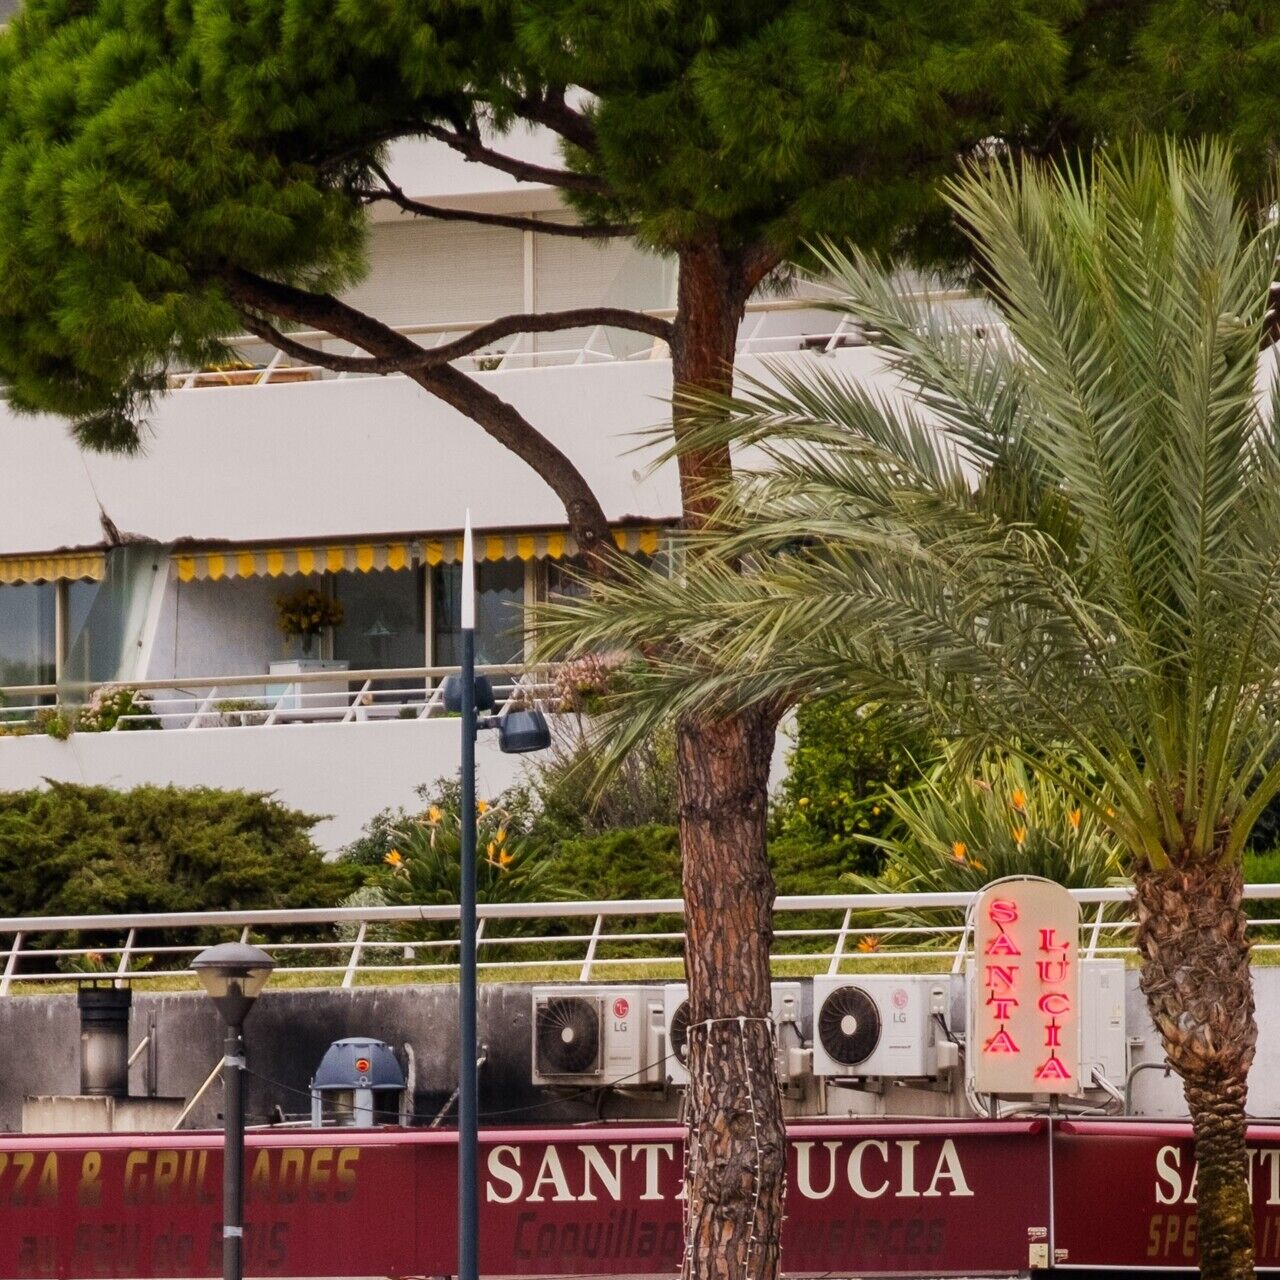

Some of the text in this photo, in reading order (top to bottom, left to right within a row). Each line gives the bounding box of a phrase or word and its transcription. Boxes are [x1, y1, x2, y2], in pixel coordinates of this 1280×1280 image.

[984, 899, 1021, 1053] SANTA
[1035, 929, 1072, 1079] LUCIA
[613, 1020, 627, 1033] LG
[892, 1012, 907, 1024] LG
[122, 1147, 361, 1205] GRILADES
[486, 1138, 975, 1204] SANT UCIA
